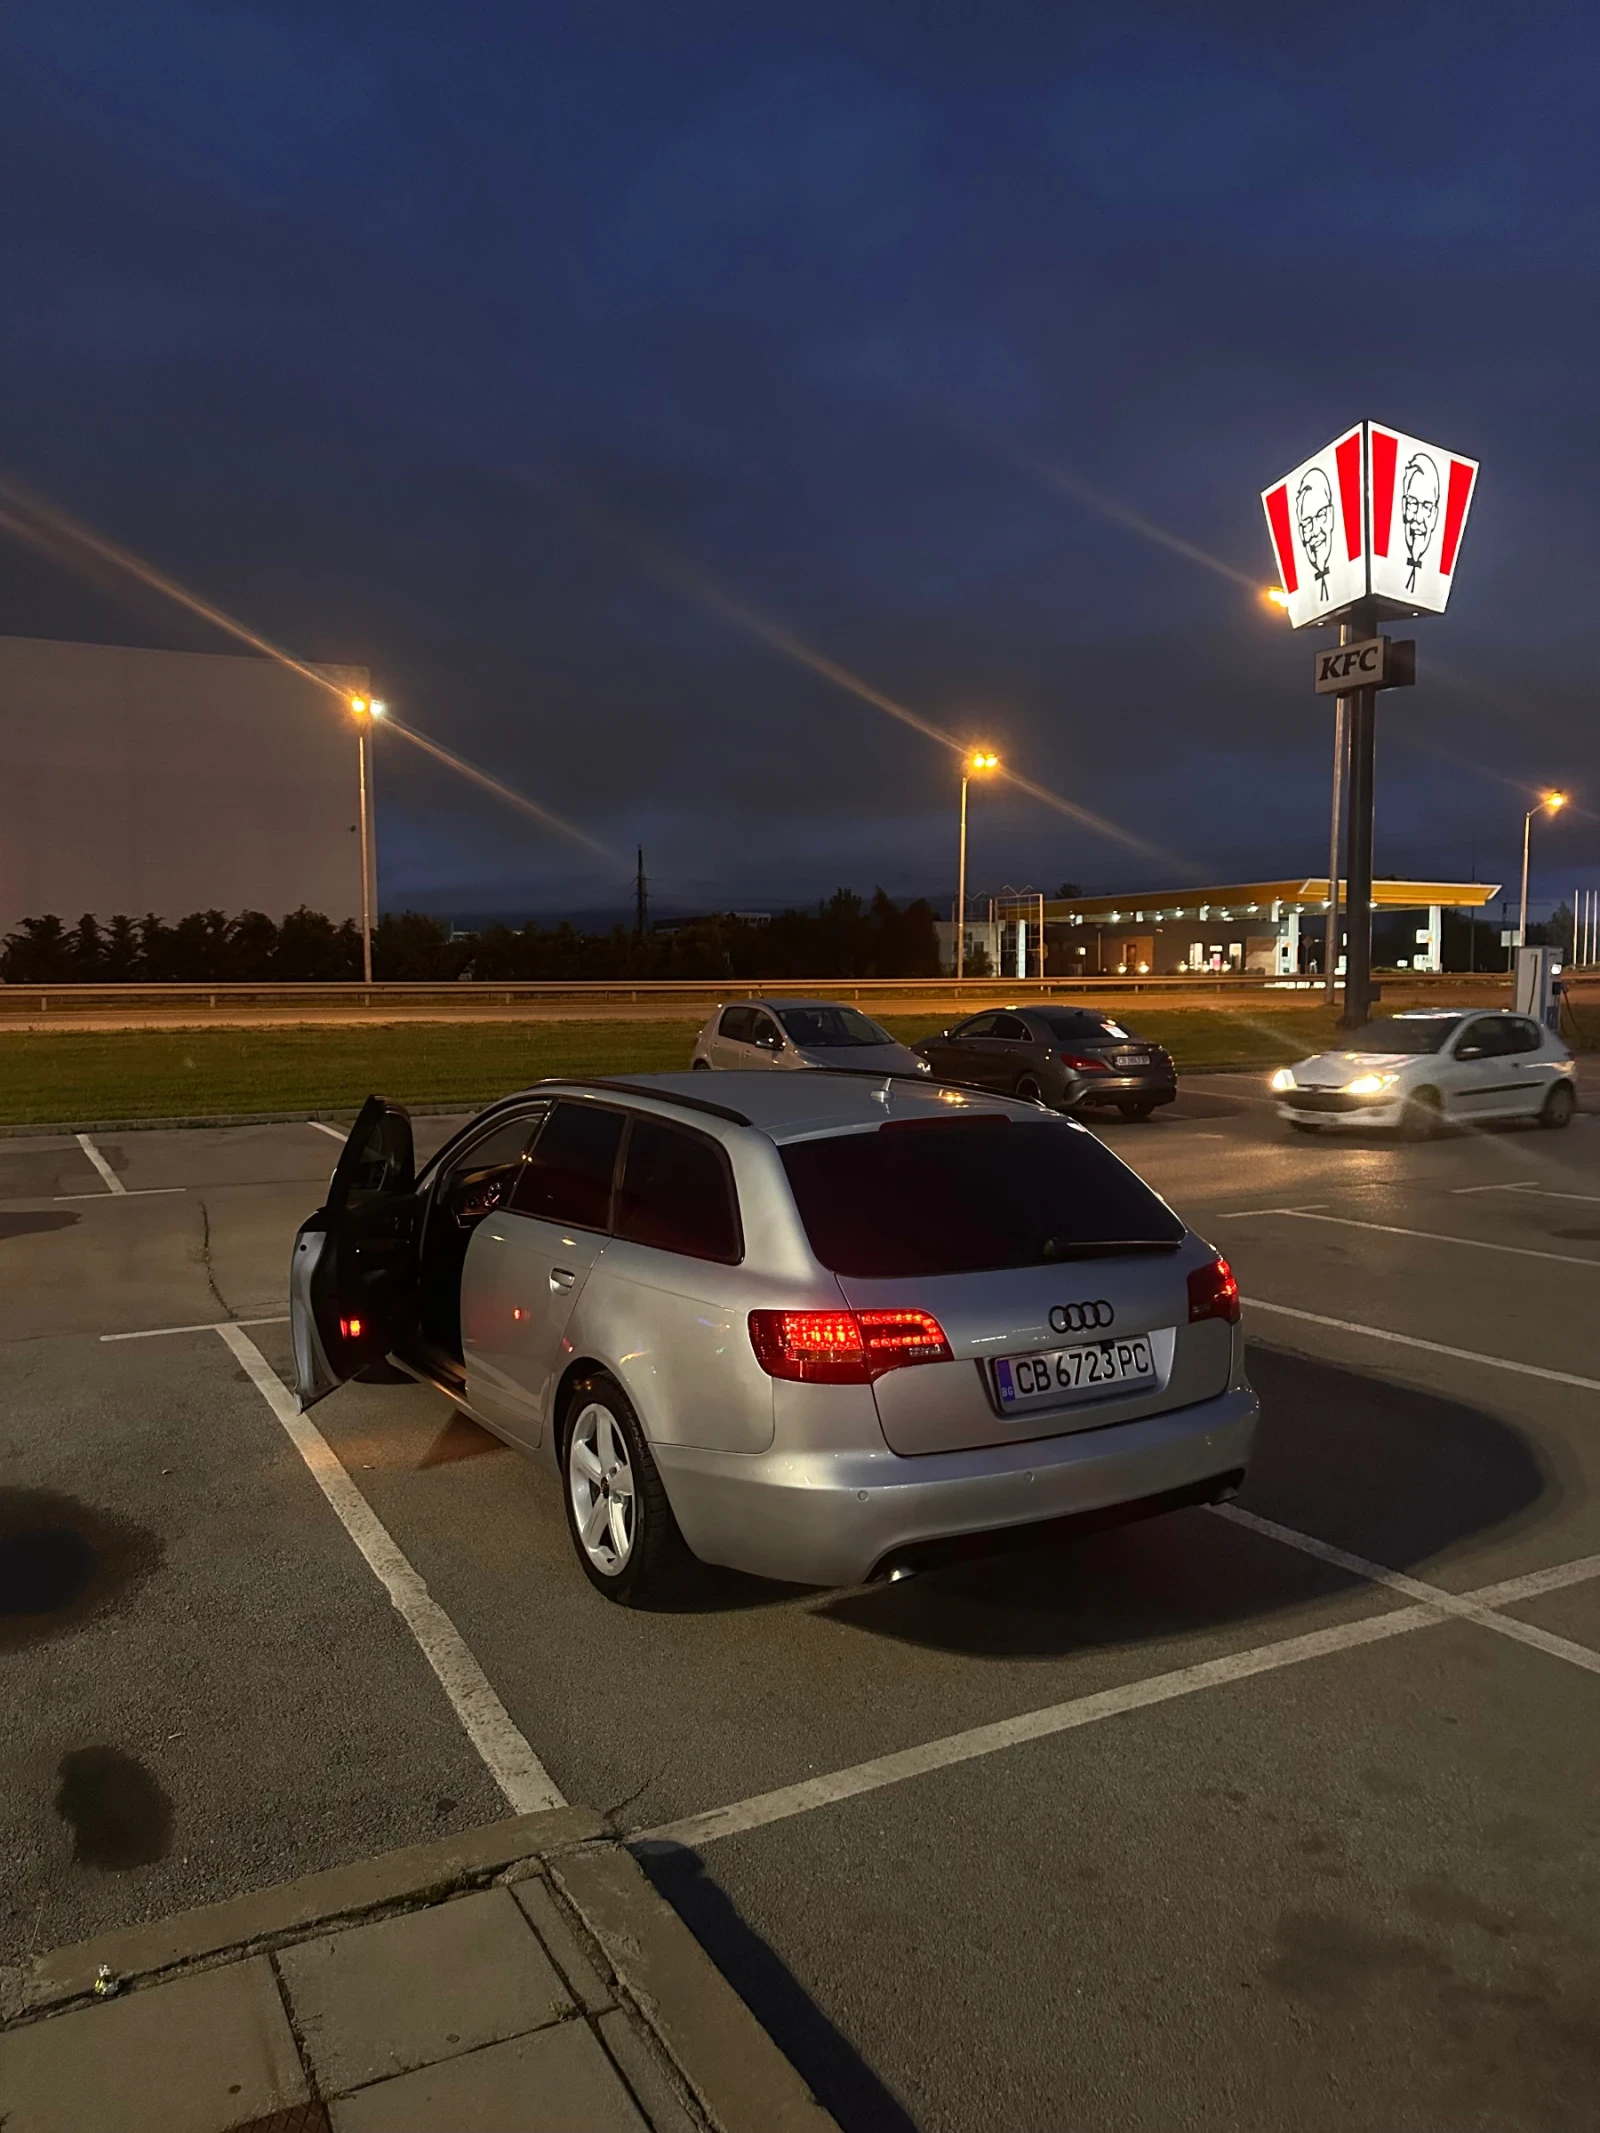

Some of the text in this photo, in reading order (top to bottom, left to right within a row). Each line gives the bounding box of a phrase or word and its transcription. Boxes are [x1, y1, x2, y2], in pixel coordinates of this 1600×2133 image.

[1319, 646, 1378, 681] KFC
[1002, 1387, 1014, 1397] BG
[1016, 1359, 1051, 1394] CB
